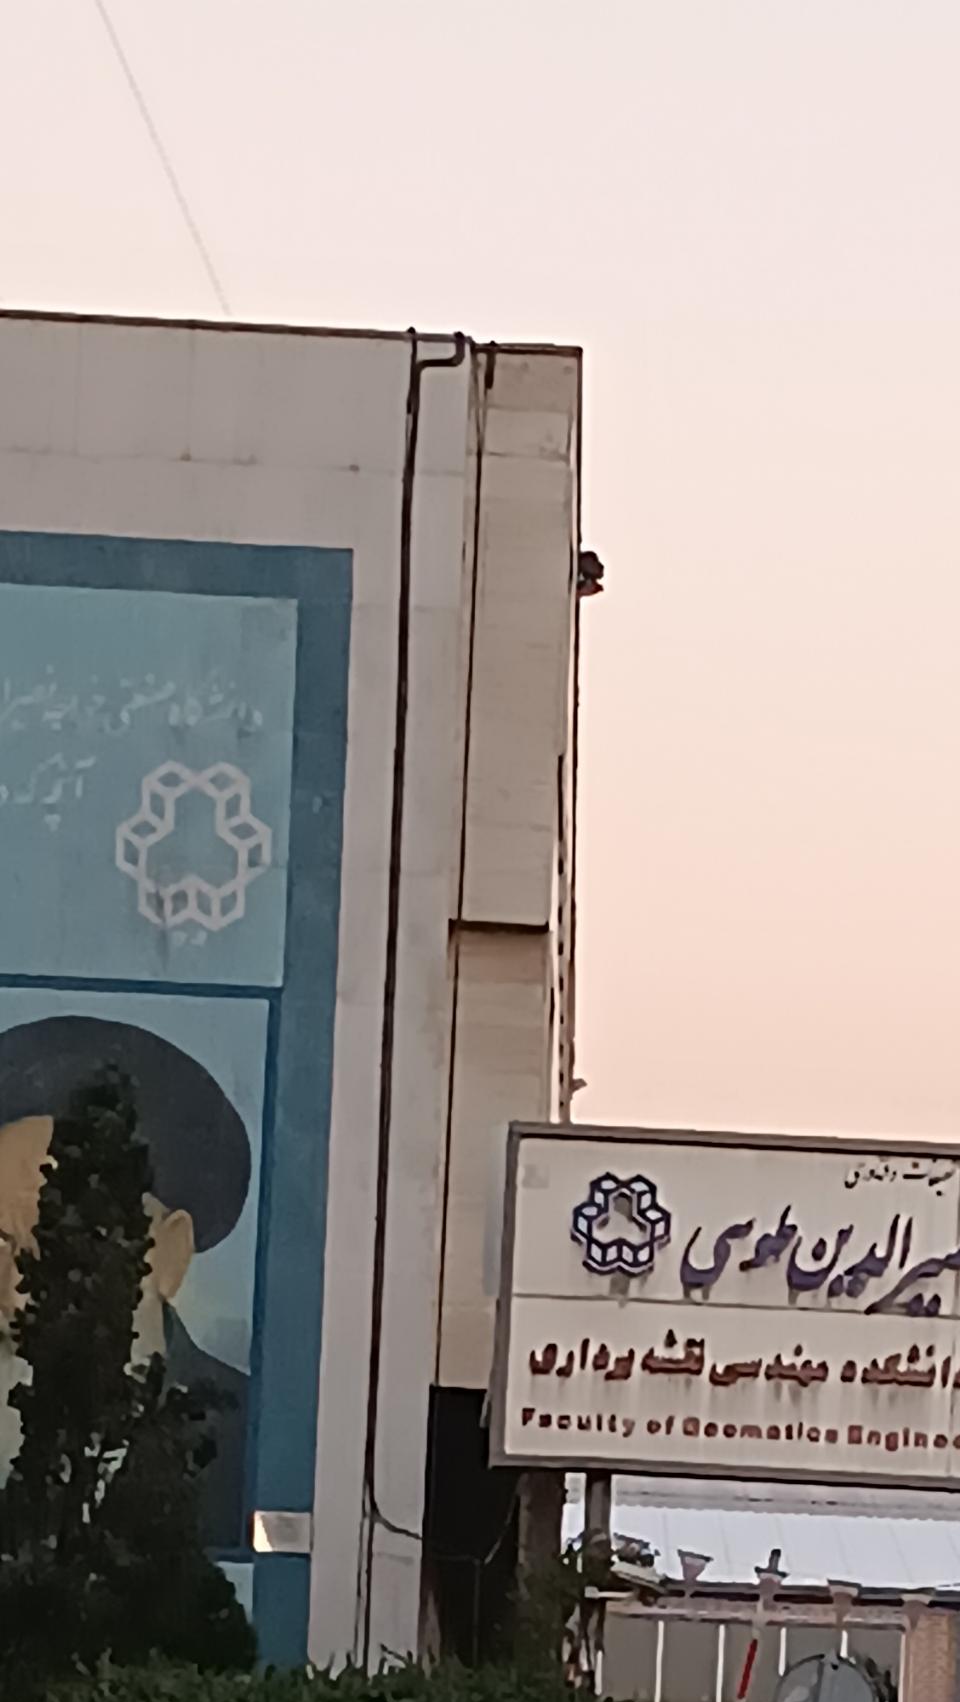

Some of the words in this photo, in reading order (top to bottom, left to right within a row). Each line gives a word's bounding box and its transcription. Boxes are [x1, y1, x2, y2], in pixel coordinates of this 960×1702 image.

[679, 1203, 799, 1291] طوسی
[708, 1343, 829, 1388] مهندسی
[521, 1406, 636, 1439] Faculty
[645, 1414, 676, 1436] of
